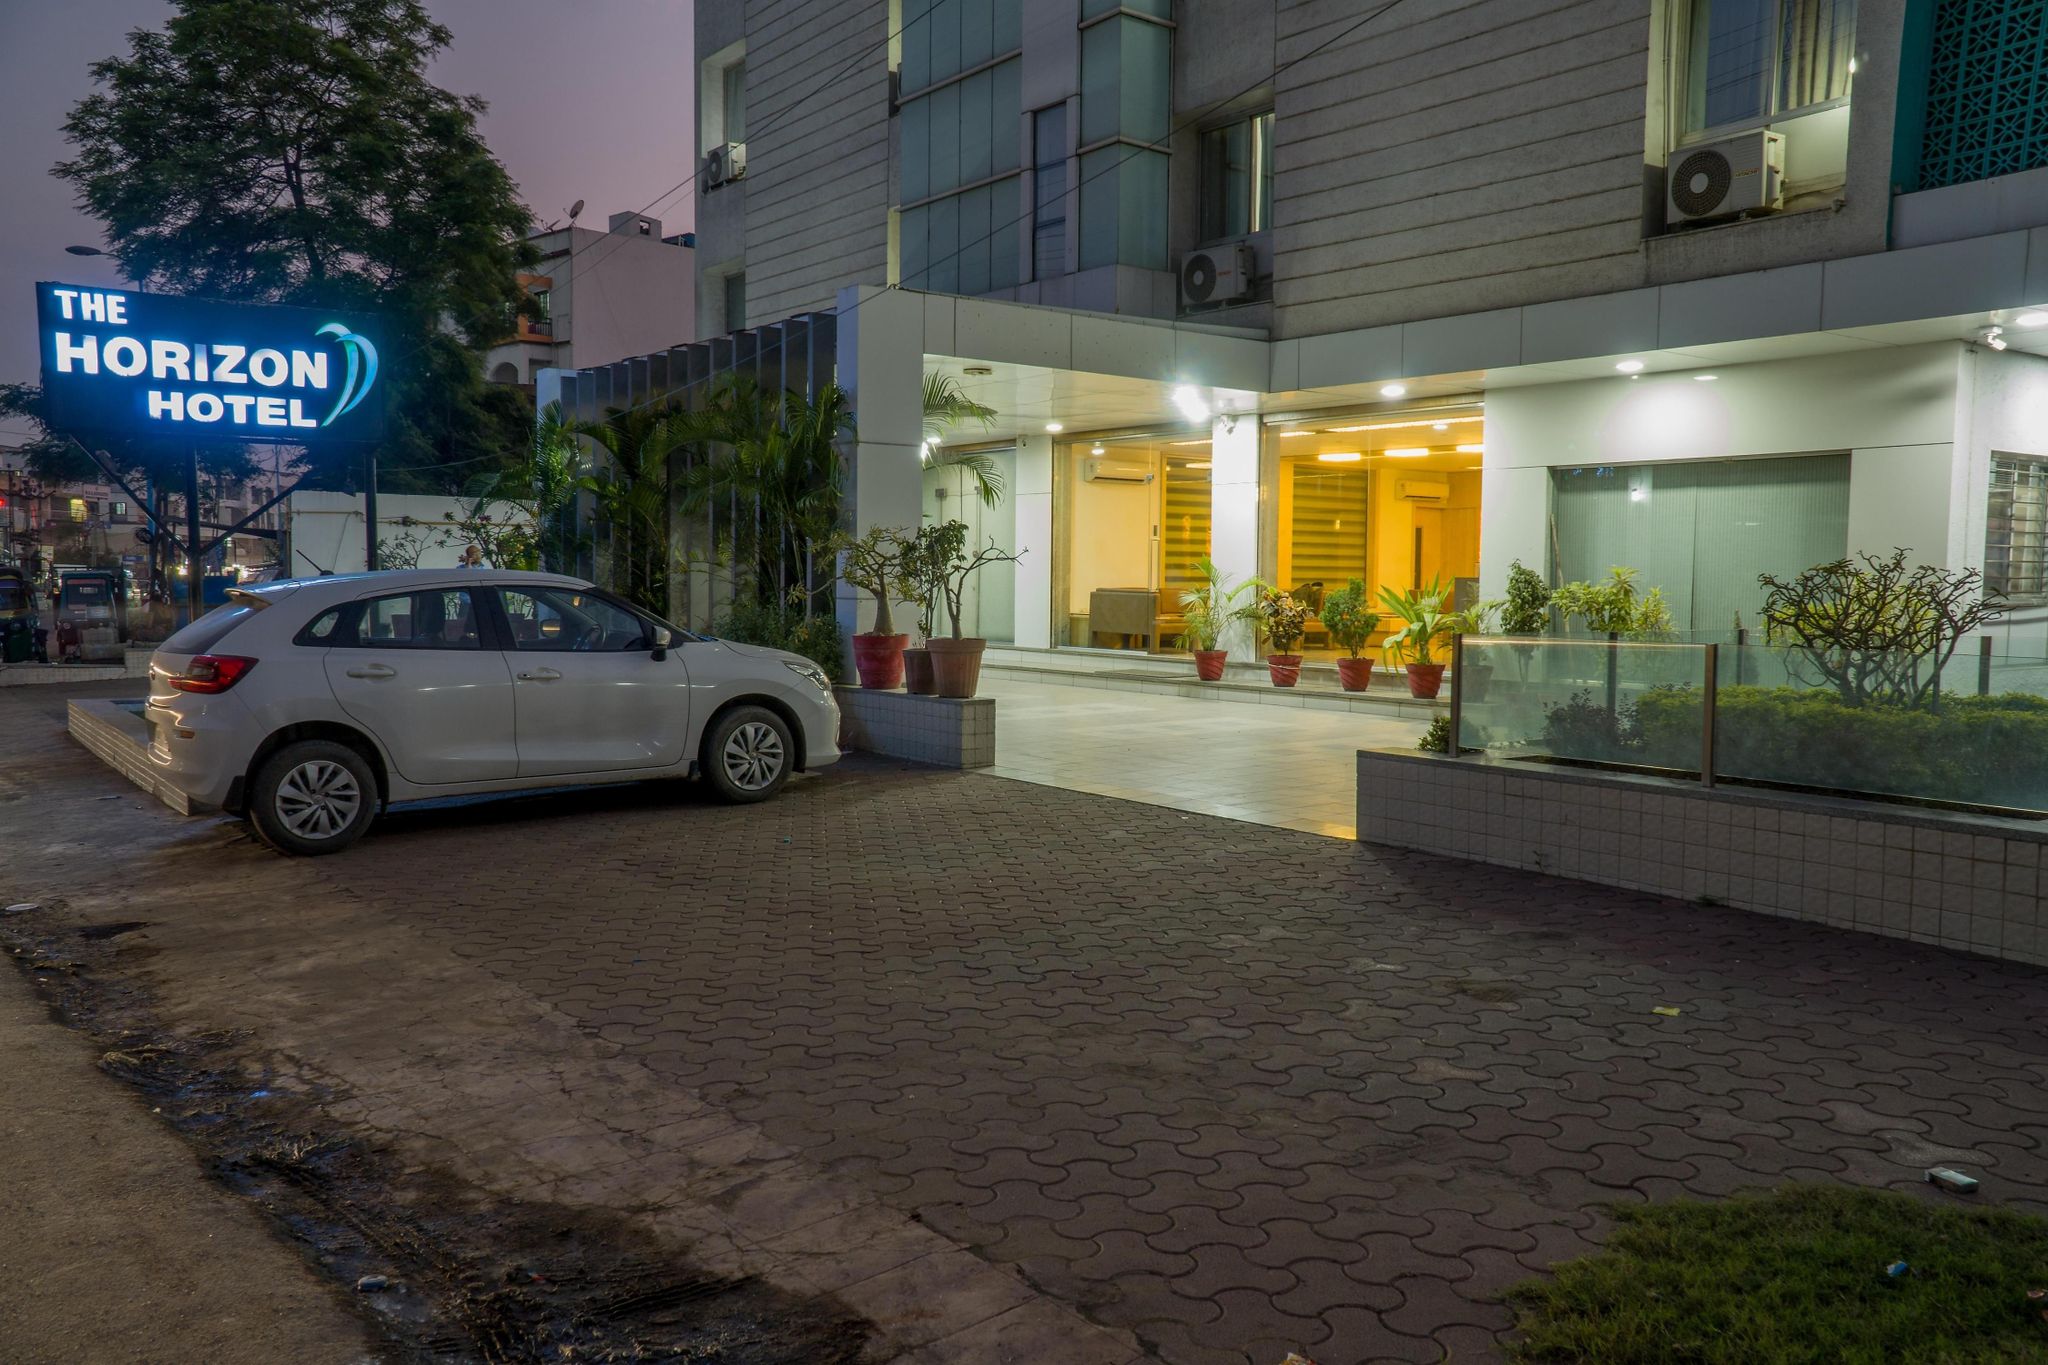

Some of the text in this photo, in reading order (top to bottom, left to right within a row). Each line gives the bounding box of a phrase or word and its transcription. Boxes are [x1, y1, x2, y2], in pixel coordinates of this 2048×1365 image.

[53, 289, 128, 325] THE
[55, 331, 329, 389] HORIZON
[148, 390, 318, 428] HOTEL
